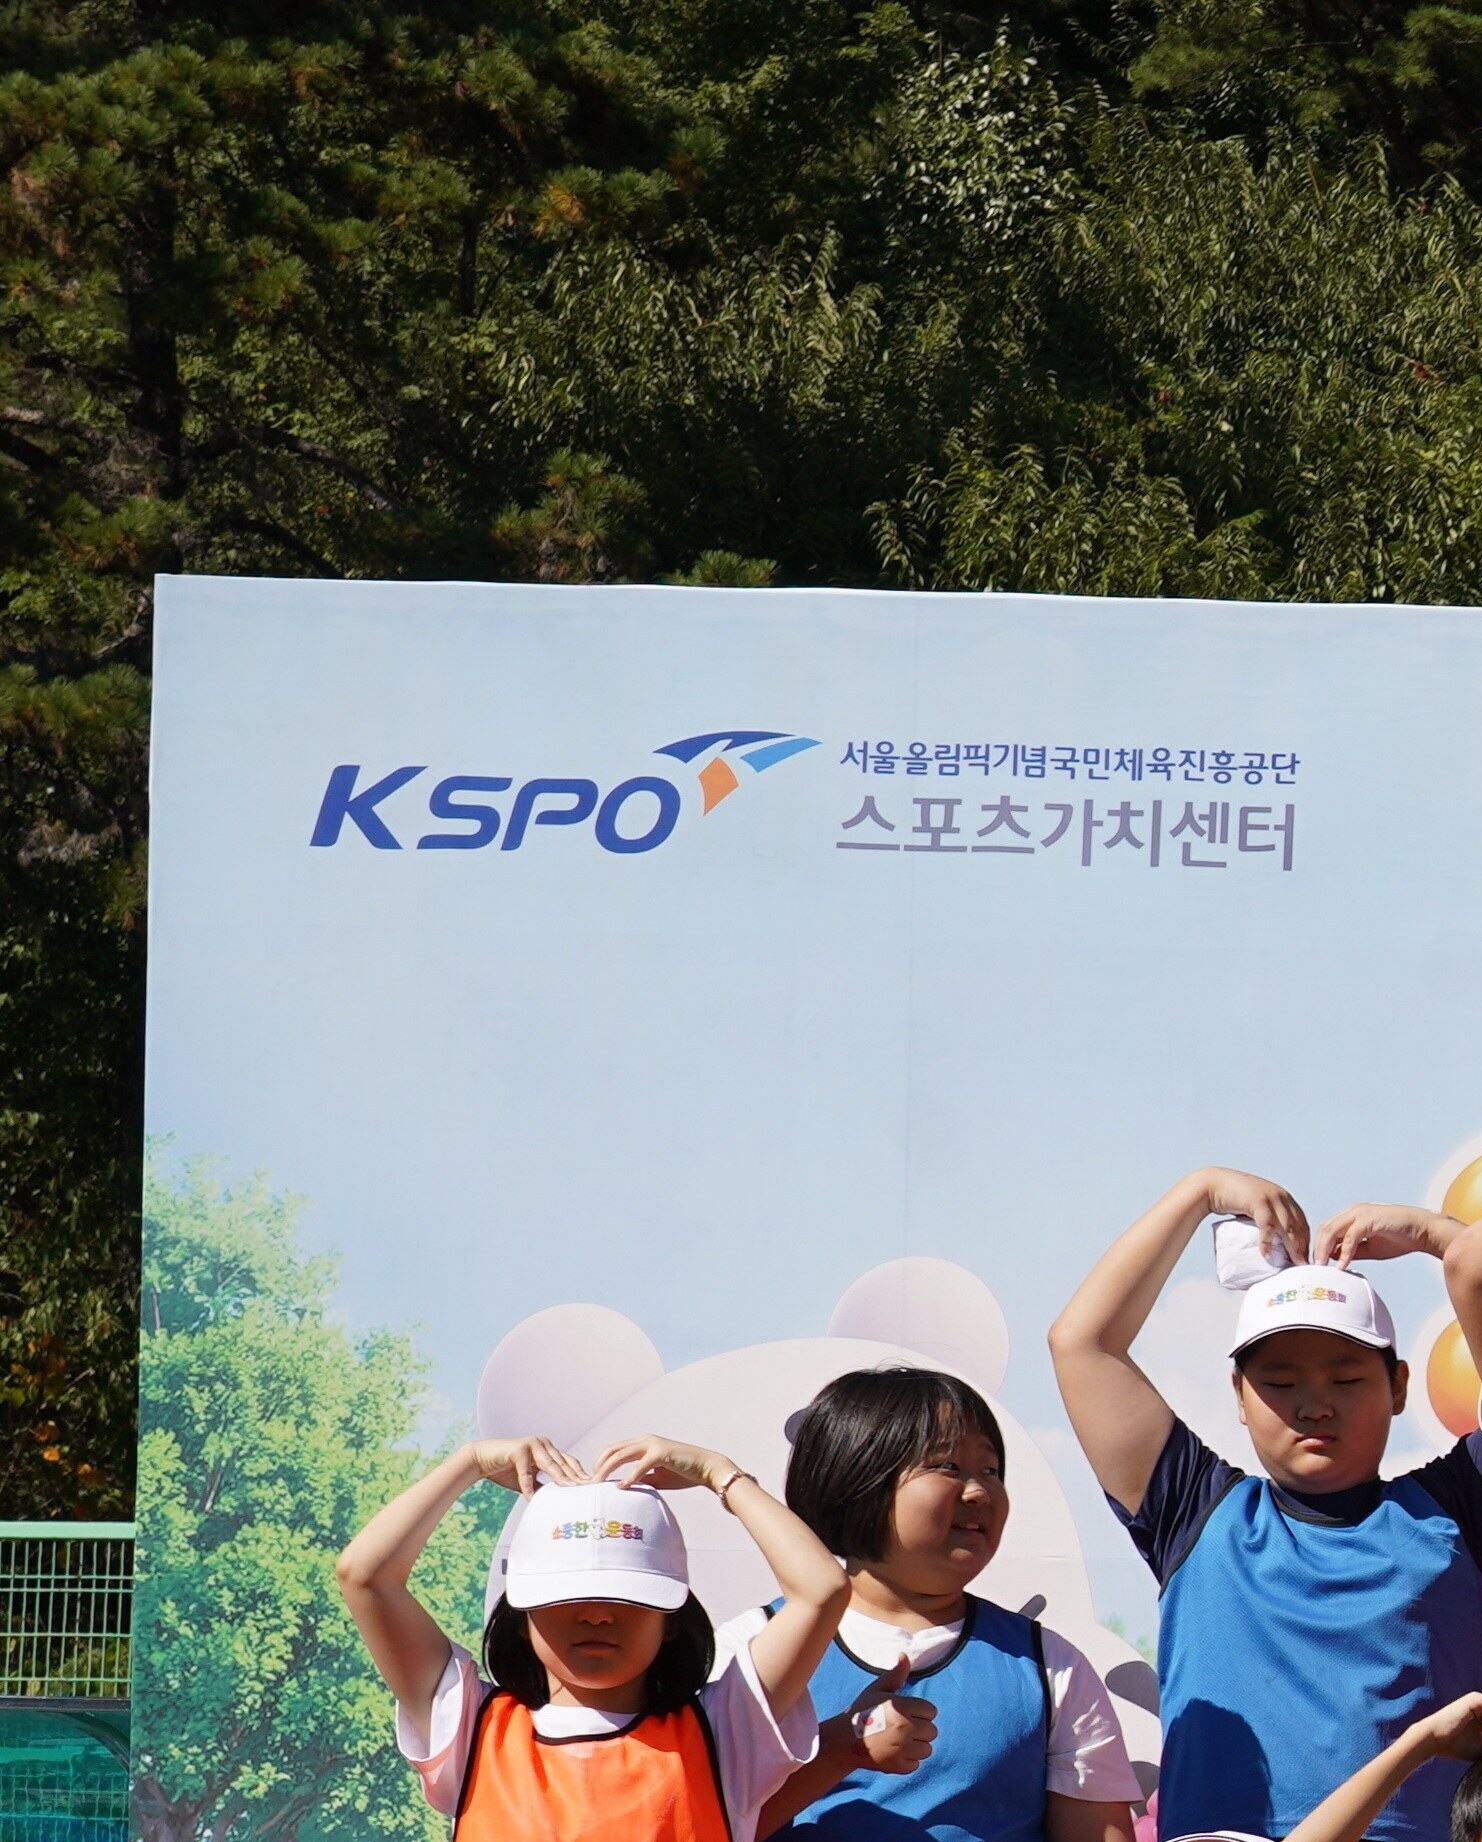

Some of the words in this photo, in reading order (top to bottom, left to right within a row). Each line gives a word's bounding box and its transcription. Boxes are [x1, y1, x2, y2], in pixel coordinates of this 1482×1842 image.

[839, 740, 1301, 786] 서울올림픽기념국민체육진흥공단
[309, 765, 681, 855] KSPO
[835, 795, 1295, 872] 스포츠가치센터
